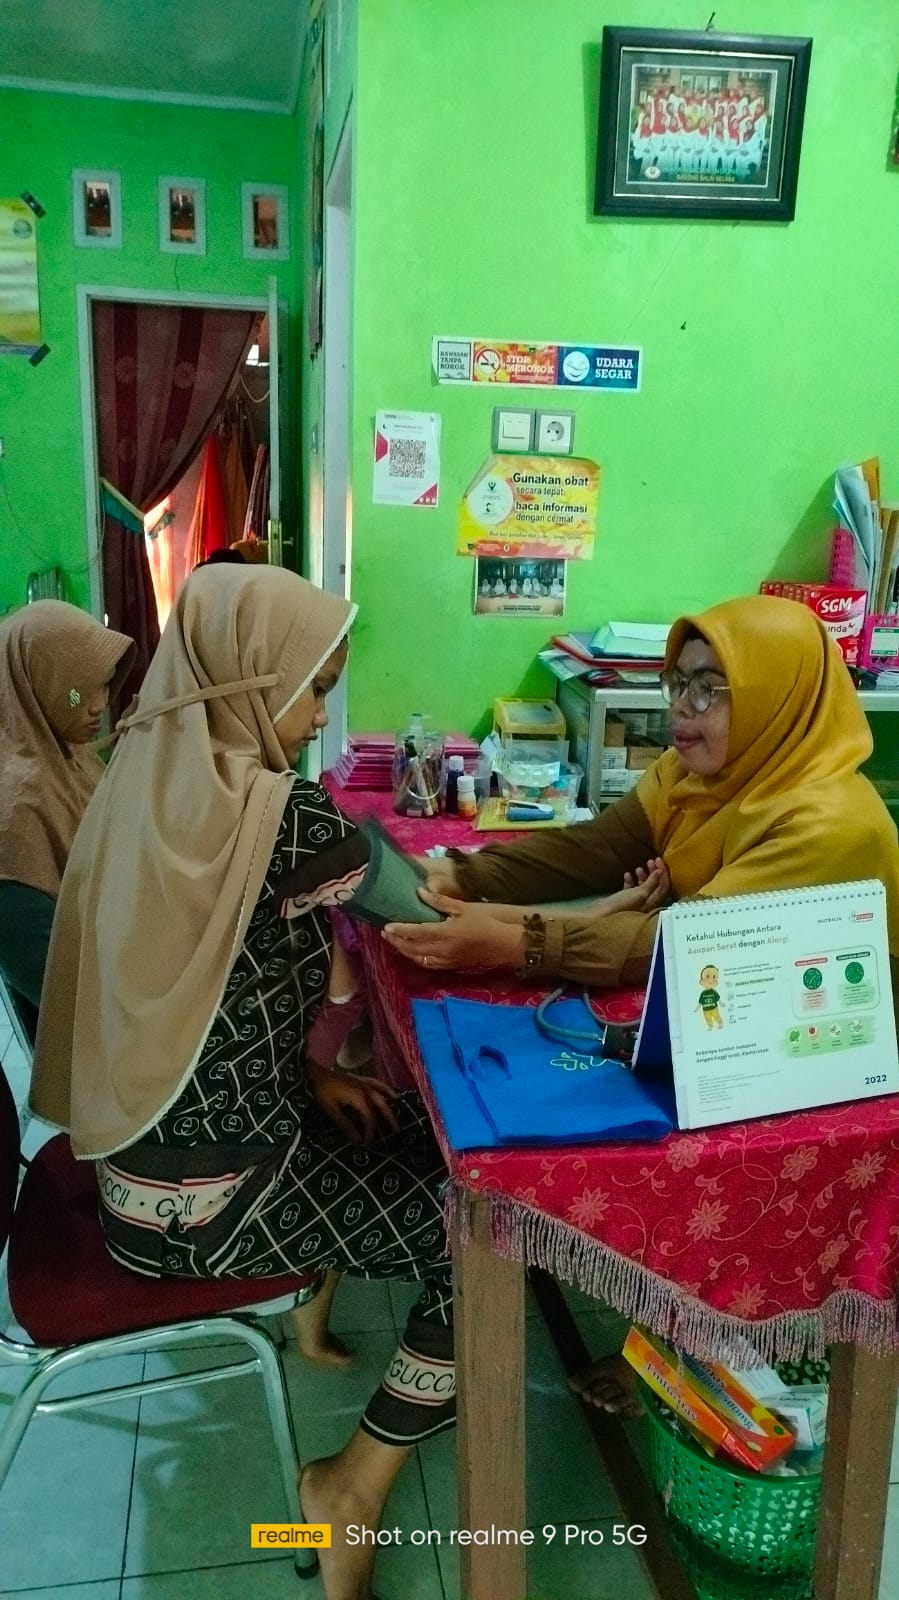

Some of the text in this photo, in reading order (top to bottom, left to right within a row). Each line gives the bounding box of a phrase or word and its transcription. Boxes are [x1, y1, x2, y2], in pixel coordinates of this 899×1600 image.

[506, 355, 531, 363] STOP
[596, 357, 633, 368] UDARA
[506, 364, 555, 374] MEROKOK
[595, 368, 632, 379] SEGAR
[513, 472, 589, 486] Gunakan obat
[515, 487, 542, 495] secara
[515, 500, 540, 511] baca
[542, 502, 588, 513] informasi
[515, 513, 574, 523] dengan cermat
[820, 597, 853, 614] SGM
[686, 924, 782, 942] Ketahui Hubungan Antara
[687, 934, 790, 955] Asupan Serat dengan Alergi
[864, 1074, 888, 1085] 2022
